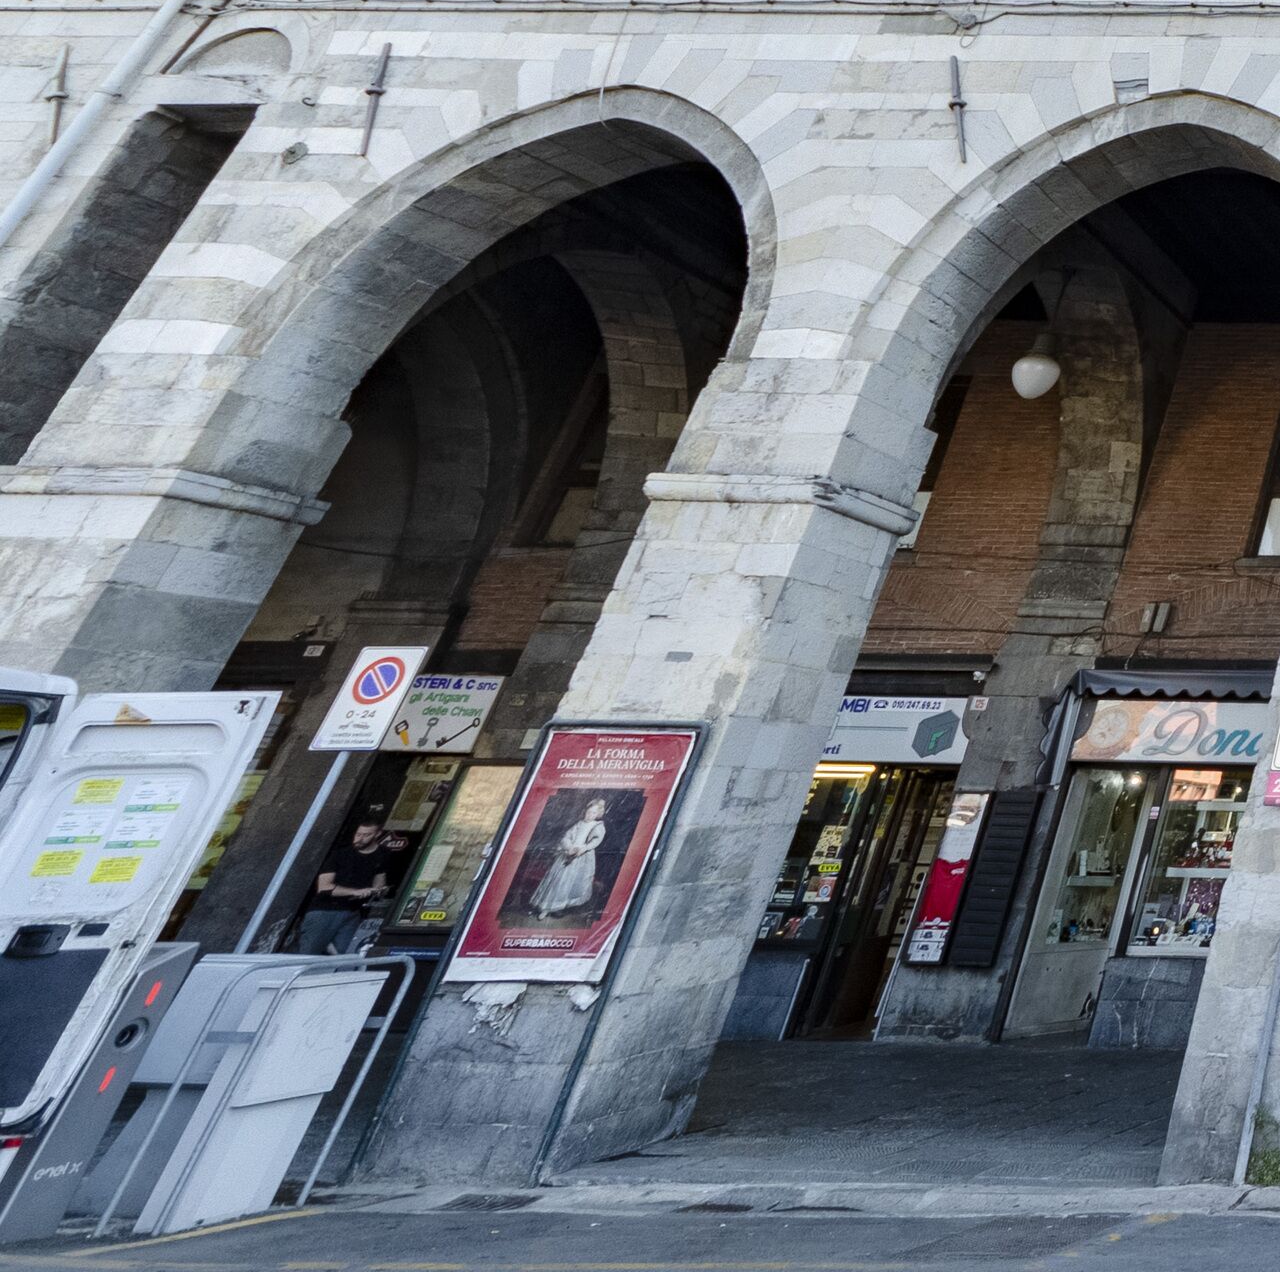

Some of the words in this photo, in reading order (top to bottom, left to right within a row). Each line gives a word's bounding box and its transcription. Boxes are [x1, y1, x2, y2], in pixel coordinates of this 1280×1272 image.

[412, 677, 452, 690] STERI
[452, 677, 464, 690] &
[464, 678, 476, 690] C
[476, 681, 498, 691] snc
[426, 692, 471, 705] Artigiani
[421, 705, 449, 716] delle
[450, 706, 483, 717] Chiavi
[839, 698, 872, 713] MBI
[586, 748, 601, 759] LA
[603, 748, 645, 760] FORMA
[556, 758, 595, 770] DELLA
[596, 759, 666, 771] MERAVIGLIA
[504, 937, 574, 948] SUPERBAROCCO
[33, 1161, 71, 1181] enel
